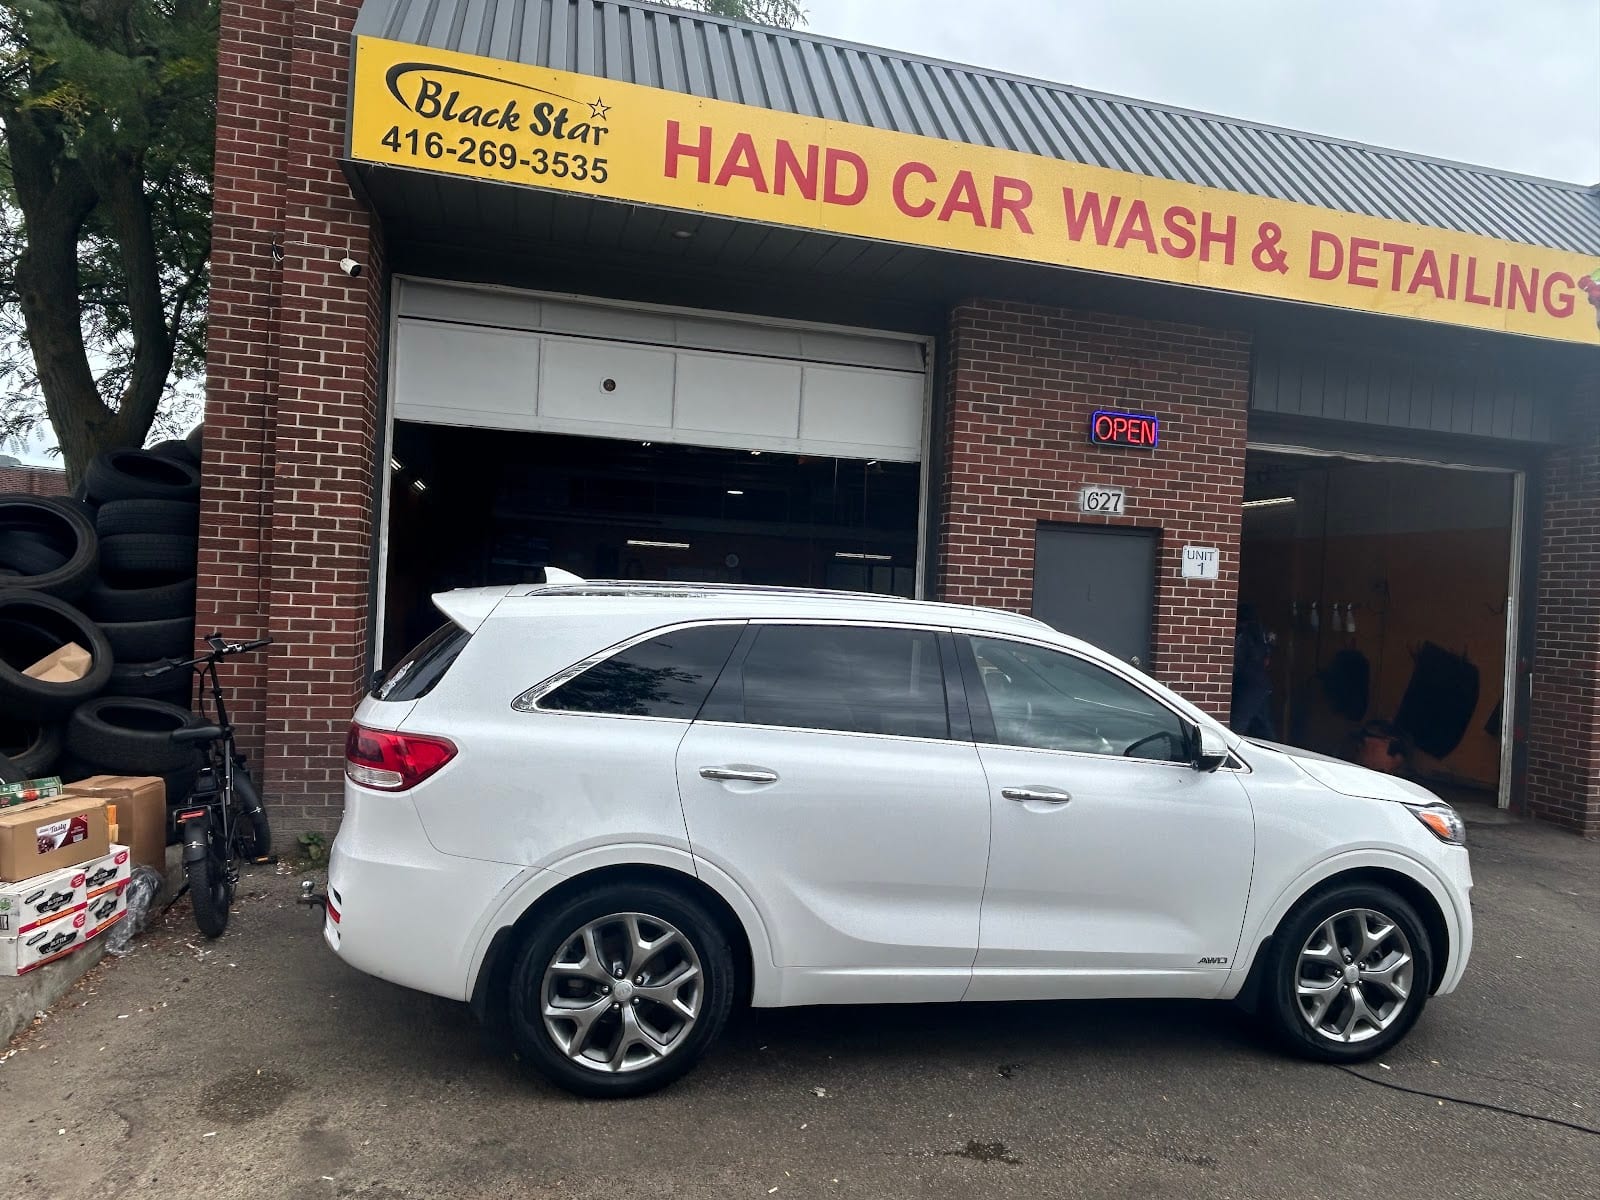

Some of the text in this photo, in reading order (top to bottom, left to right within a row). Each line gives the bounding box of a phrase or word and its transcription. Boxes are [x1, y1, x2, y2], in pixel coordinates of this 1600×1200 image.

[414, 76, 609, 145] Black Star
[381, 125, 608, 184] 416-269-3535
[664, 119, 1576, 319] HAND CAR WASH & DETAILING
[1095, 415, 1156, 445] OPEN
[1086, 491, 1122, 512] 627
[1187, 549, 1215, 562] UNIT
[1197, 562, 1205, 576] 1
